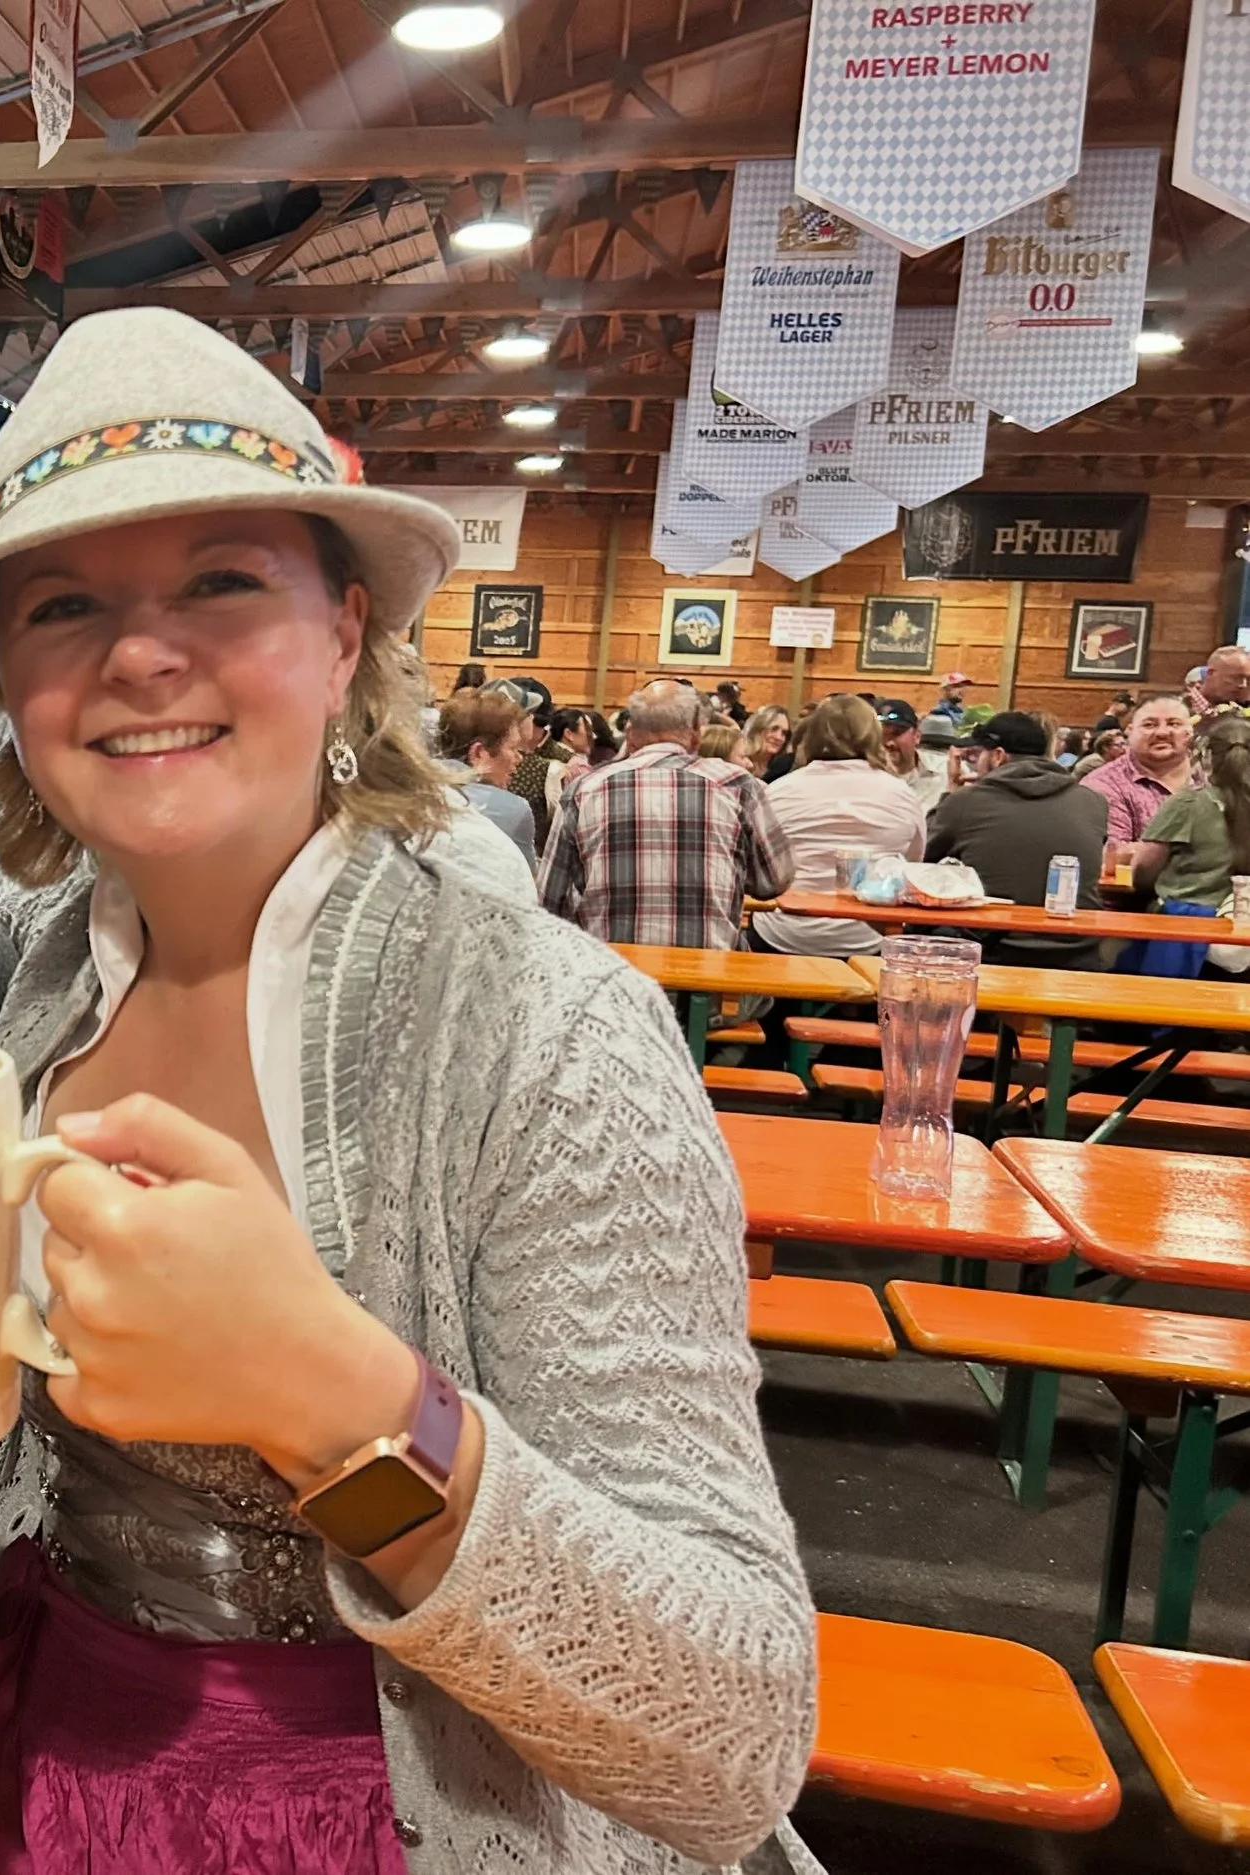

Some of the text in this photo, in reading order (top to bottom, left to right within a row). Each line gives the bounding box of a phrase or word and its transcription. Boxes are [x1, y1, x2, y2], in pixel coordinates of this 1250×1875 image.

[871, 3, 1034, 29] RASPBERRY
[844, 52, 1050, 79] MEYER LEMON
[982, 235, 1131, 280] Bitburger
[751, 264, 874, 289] Weihenstephan
[770, 312, 843, 328] HELLES
[779, 330, 833, 344] LAGER
[697, 429, 797, 440] MADE MARION
[888, 431, 951, 445] PILSNER
